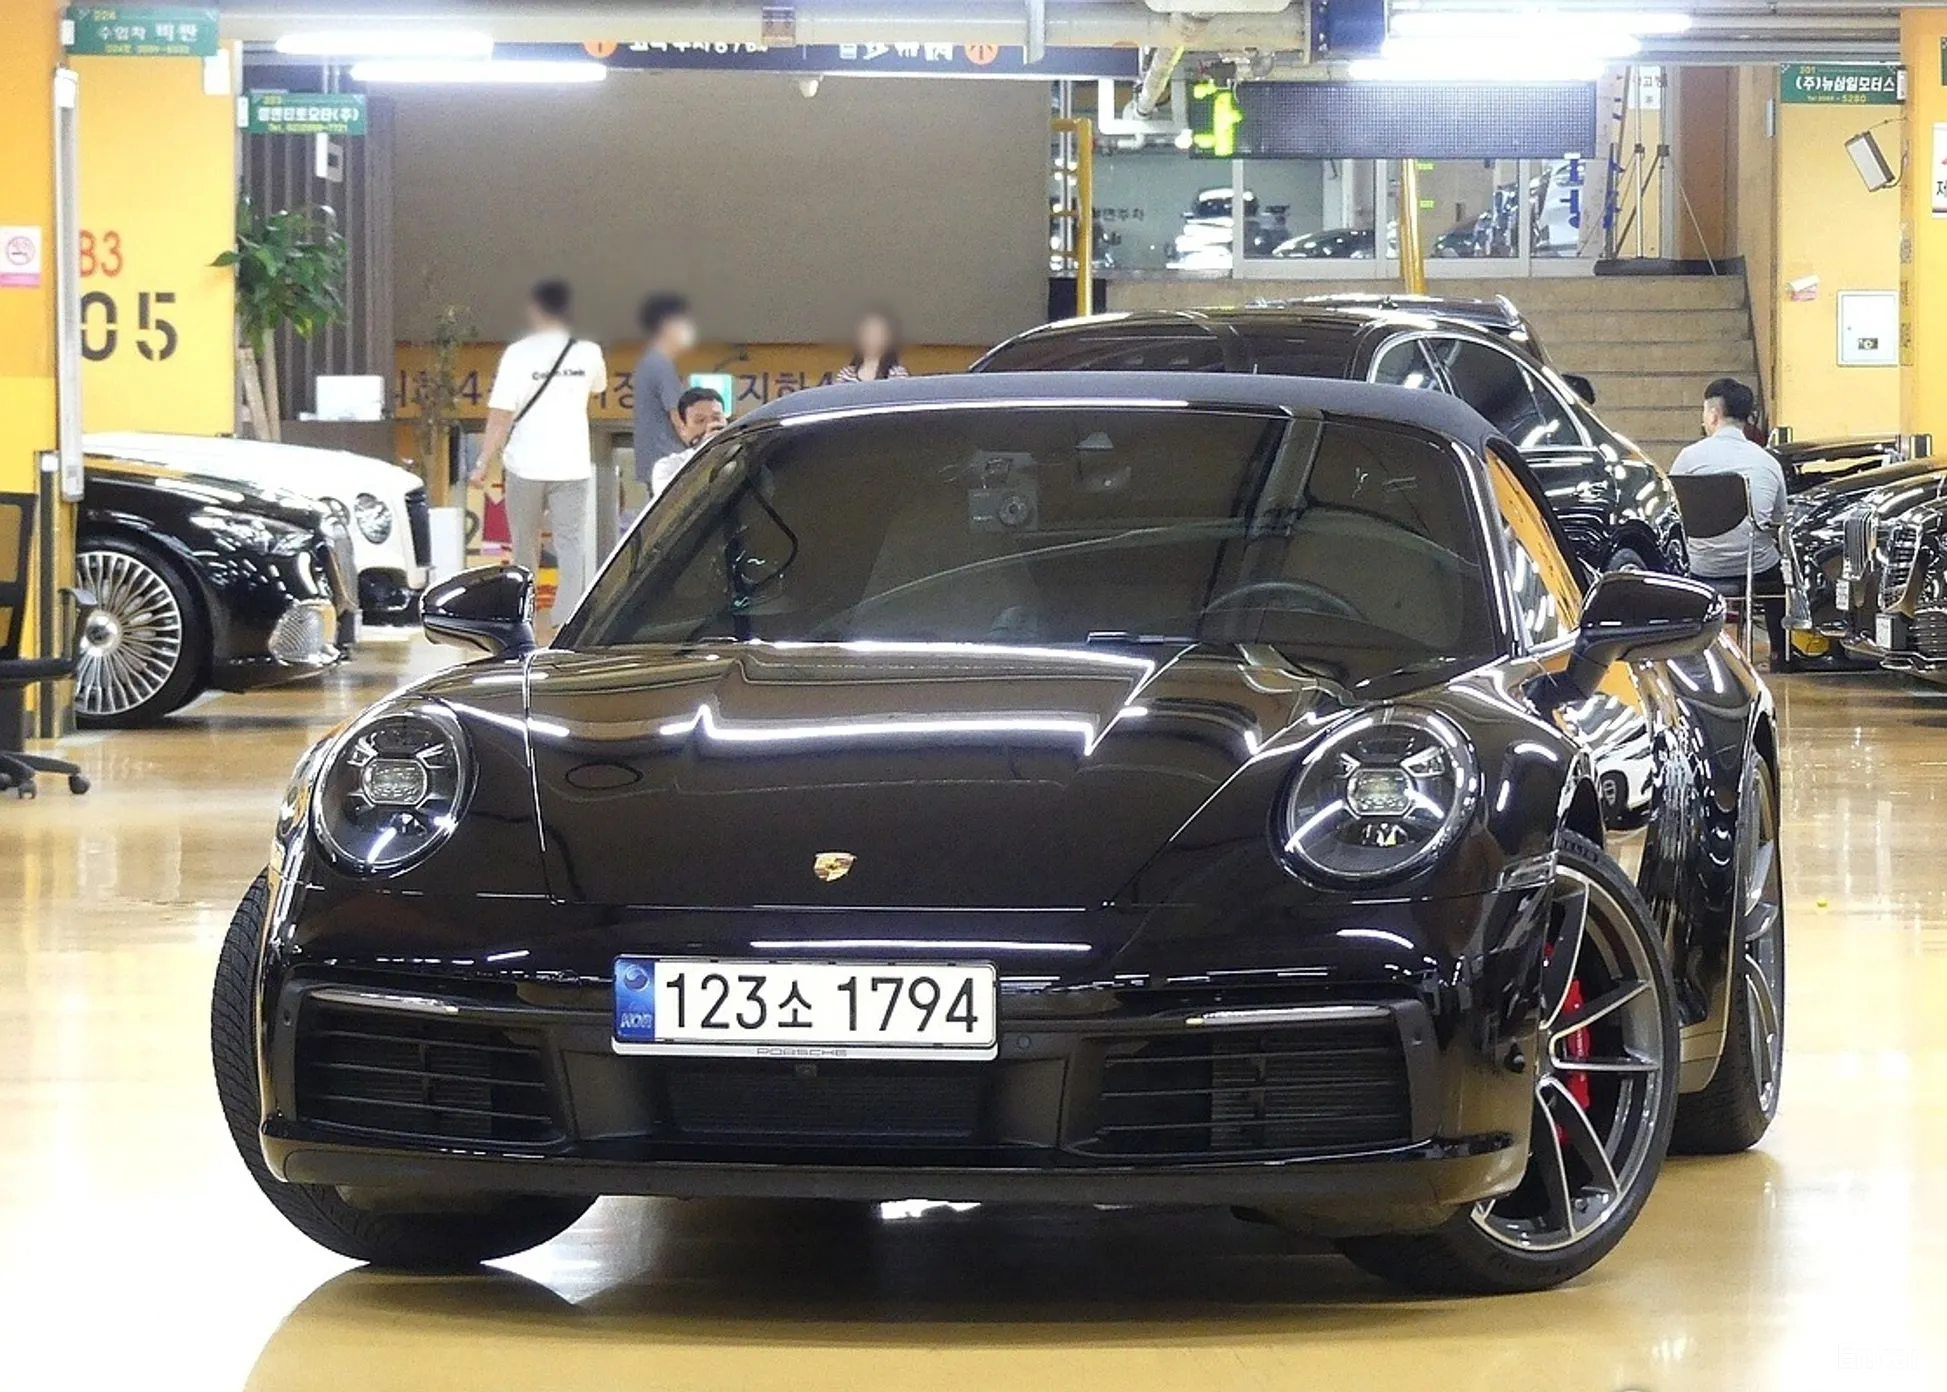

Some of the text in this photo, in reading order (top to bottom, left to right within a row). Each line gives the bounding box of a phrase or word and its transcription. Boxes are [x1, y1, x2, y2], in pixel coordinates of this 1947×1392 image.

[665, 972, 980, 1034] 123소 1794
[756, 1047, 848, 1057] PORSCHE
